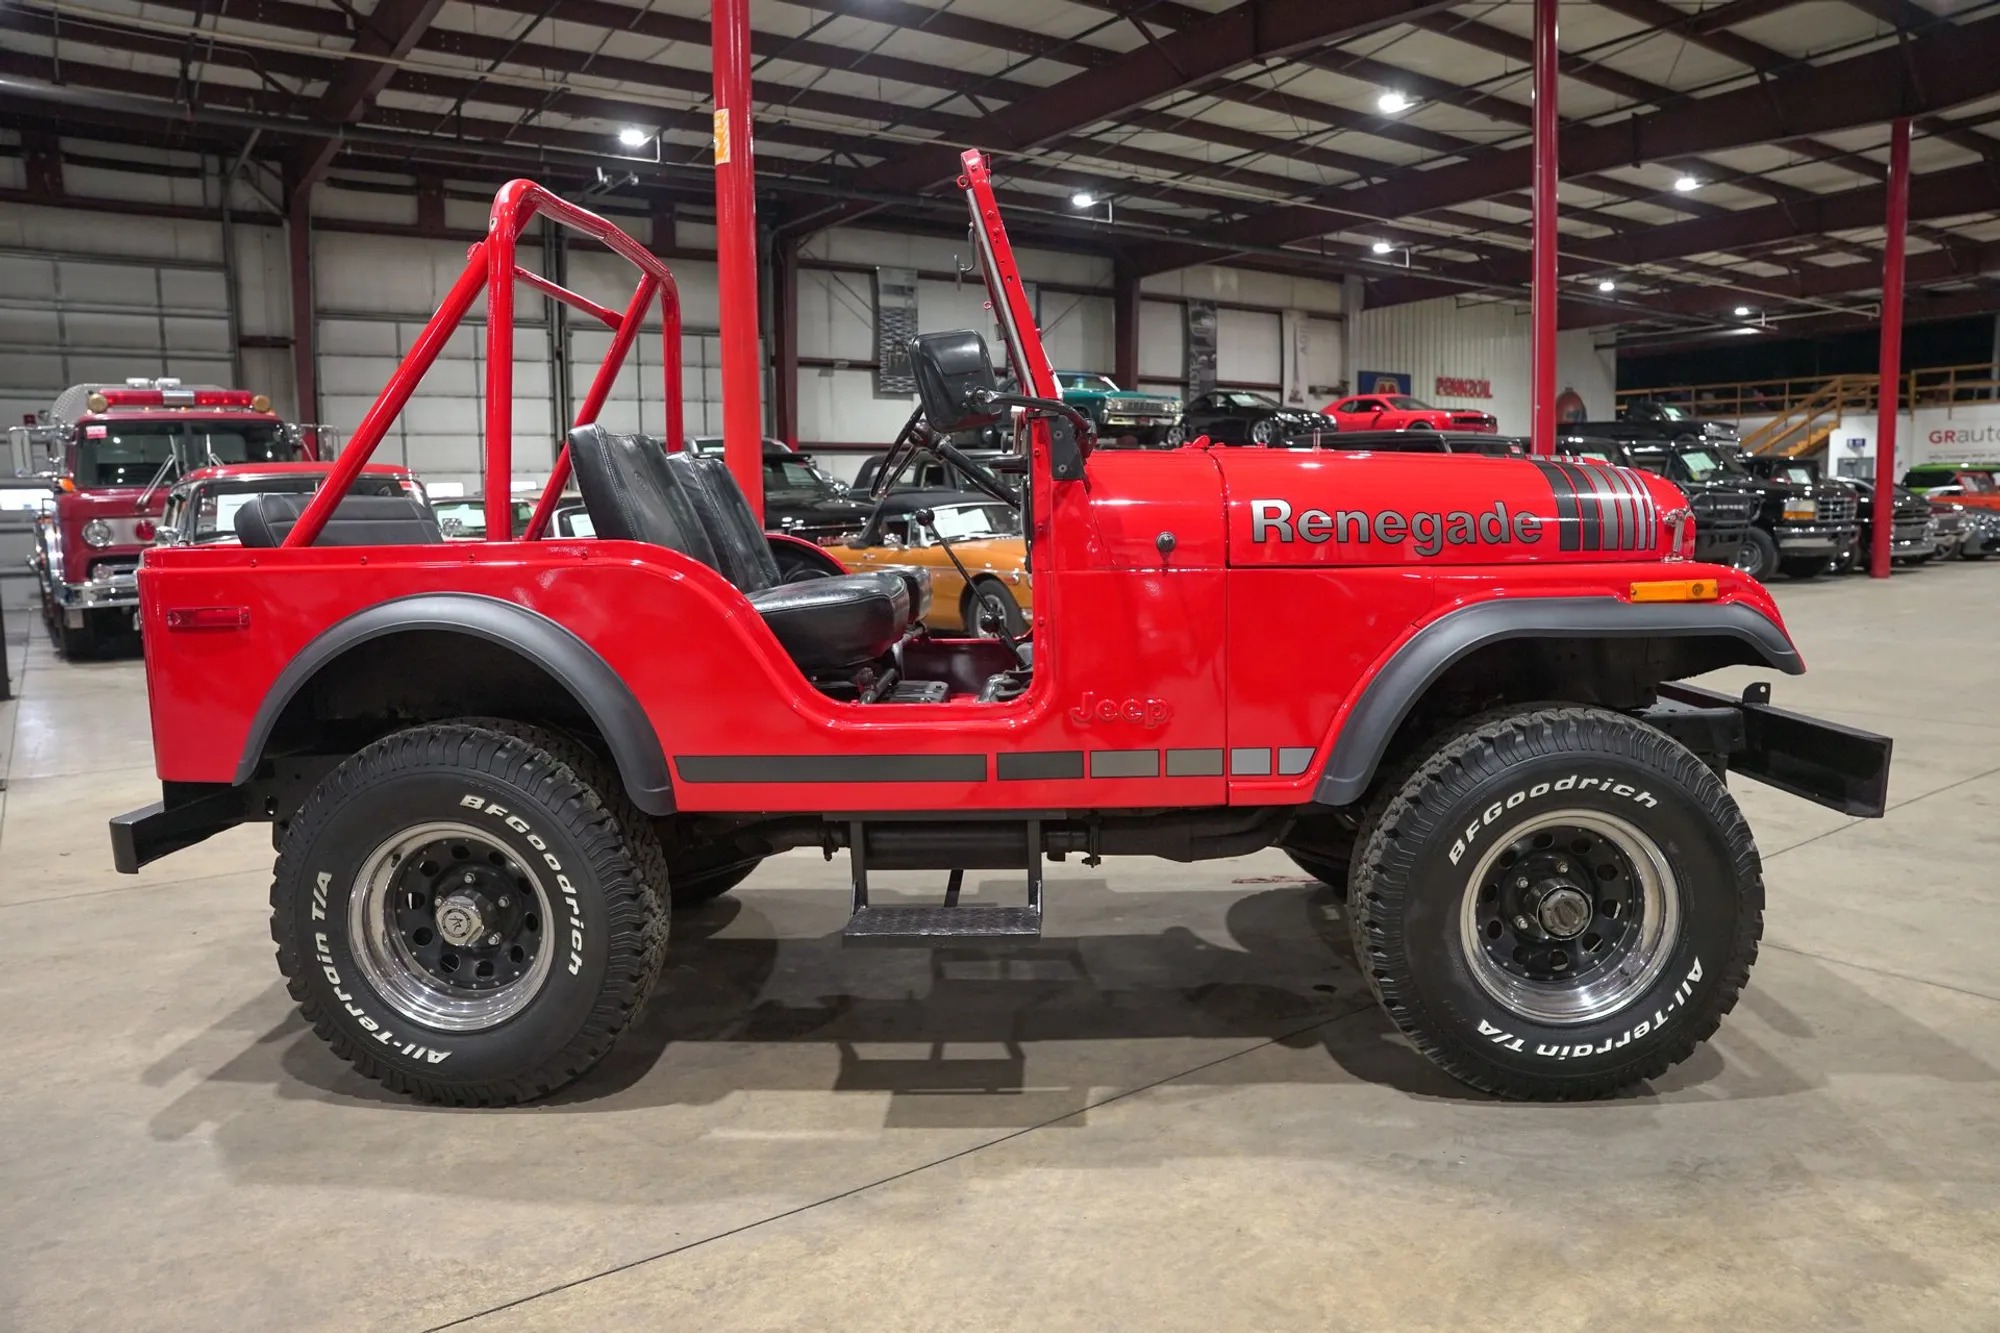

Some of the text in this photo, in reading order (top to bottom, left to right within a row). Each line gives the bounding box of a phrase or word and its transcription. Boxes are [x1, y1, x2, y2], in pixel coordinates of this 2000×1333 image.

[1250, 498, 1543, 557] Renegade
[1069, 691, 1173, 729] Jeep
[1448, 774, 1658, 866] BFGoodrich
[459, 794, 585, 976] BFGoodrich
[311, 871, 453, 1064] All-Terrain T/A
[1477, 956, 1704, 1060] All-Terrain T/A
